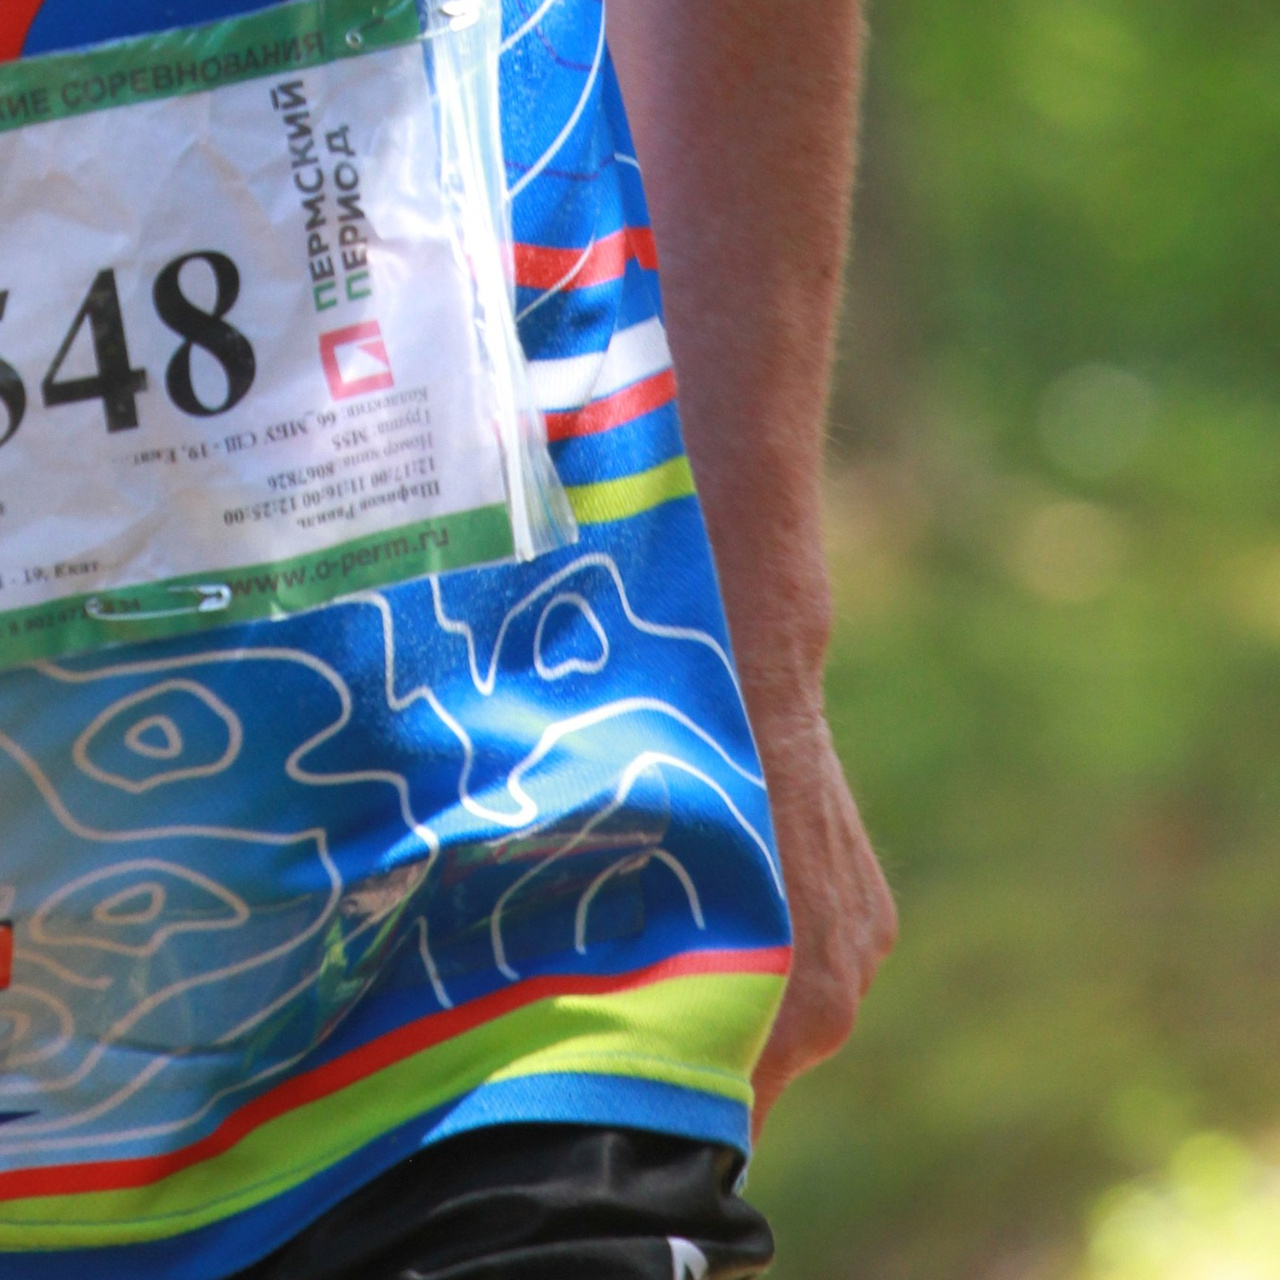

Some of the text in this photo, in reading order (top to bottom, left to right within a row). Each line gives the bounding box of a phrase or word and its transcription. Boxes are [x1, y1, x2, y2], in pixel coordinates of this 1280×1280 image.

[61, 31, 324, 107] СОРЕВНОВАНИЯ
[270, 80, 338, 312] ПЕРМСКИЙ
[325, 124, 372, 302] ПЕРИОД
[223, 494, 297, 526] 12:25:00
[228, 526, 450, 595] www.o-perm.ru
